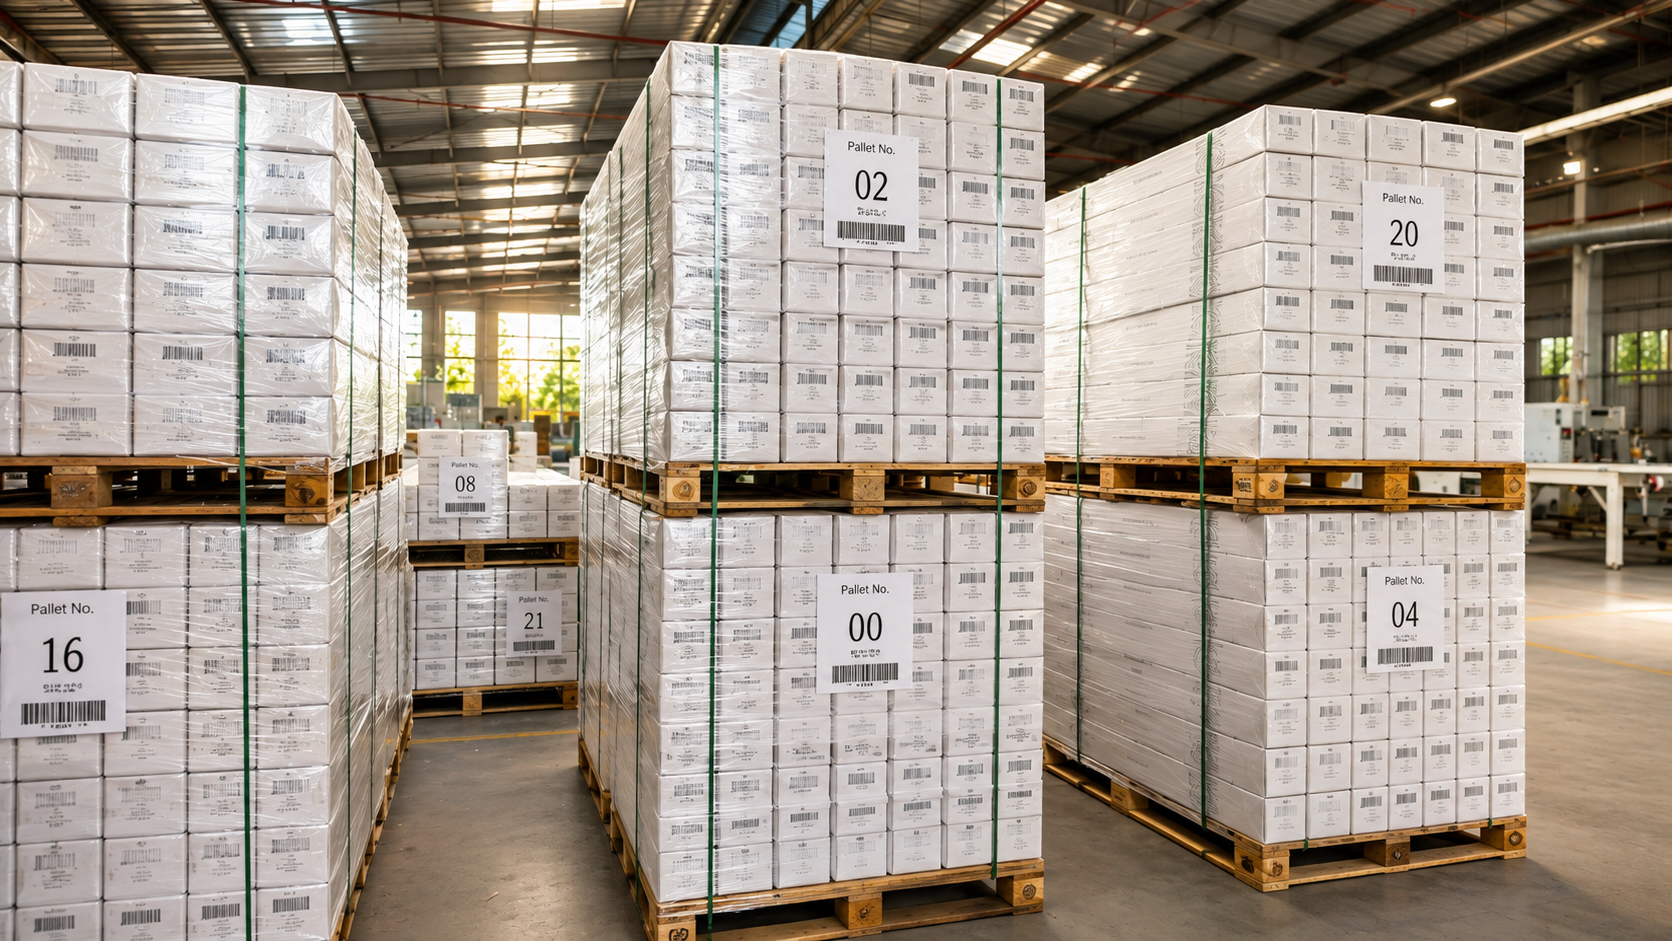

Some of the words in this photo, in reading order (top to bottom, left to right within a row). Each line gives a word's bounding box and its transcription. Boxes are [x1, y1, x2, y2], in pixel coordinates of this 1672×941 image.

[848, 141, 876, 153] Pallet
[879, 144, 895, 155] No.
[855, 169, 888, 202] 02
[1383, 193, 1407, 204] Pallet
[1409, 195, 1424, 205] No.
[1390, 219, 1419, 247] 20
[455, 475, 476, 493] 08
[841, 584, 869, 595] Pallet
[872, 583, 889, 594] No.
[1385, 576, 1408, 586] Pallet
[1410, 575, 1425, 586] No.
[31, 603, 67, 615] Pallet
[71, 602, 94, 614] No.
[1392, 600, 1419, 628] 04
[524, 611, 544, 630] 21
[848, 611, 883, 642] 00
[42, 636, 84, 673] 16
